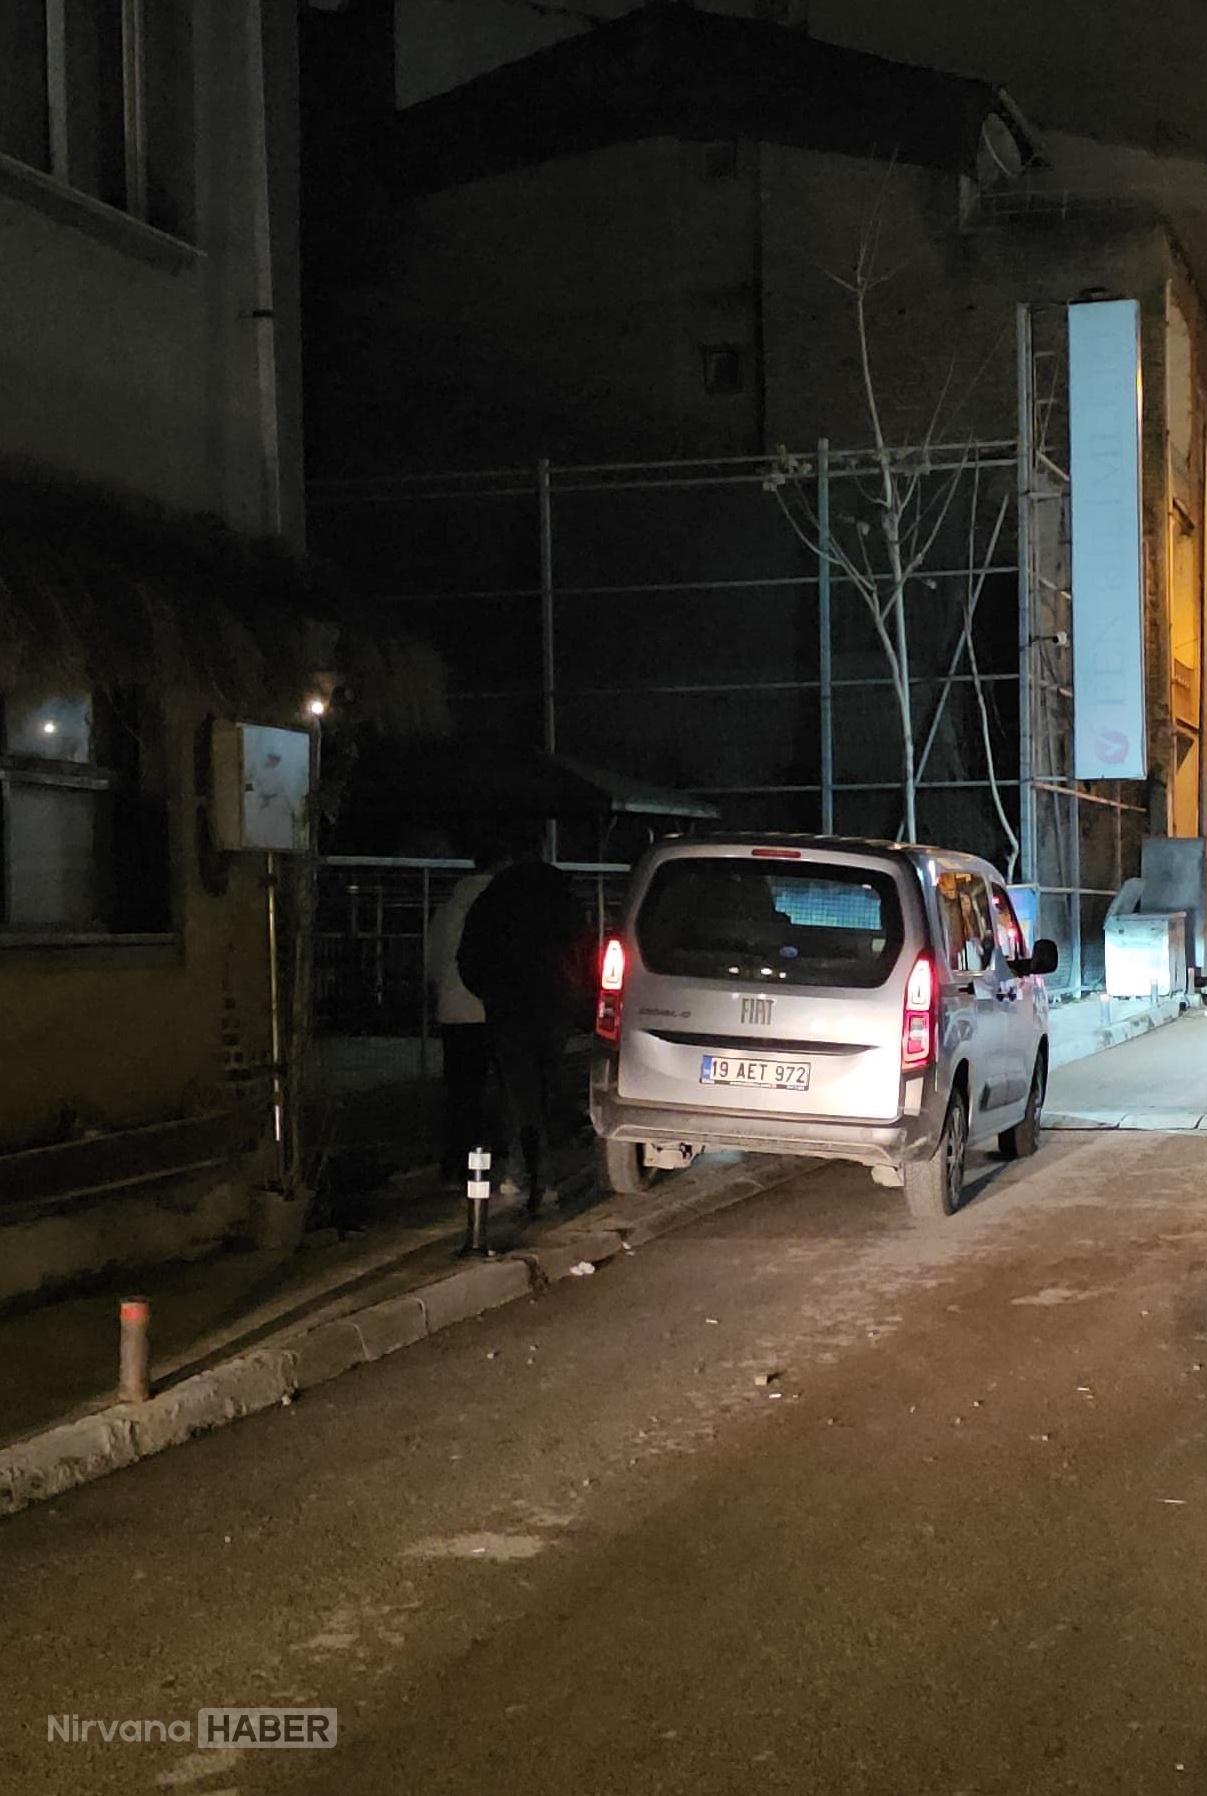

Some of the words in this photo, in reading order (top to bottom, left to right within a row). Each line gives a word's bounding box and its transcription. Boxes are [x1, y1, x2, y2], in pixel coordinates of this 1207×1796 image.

[740, 997, 774, 1026] FIAT
[712, 1060, 729, 1078] 19
[736, 1062, 768, 1081] AET
[774, 1065, 806, 1084] 972
